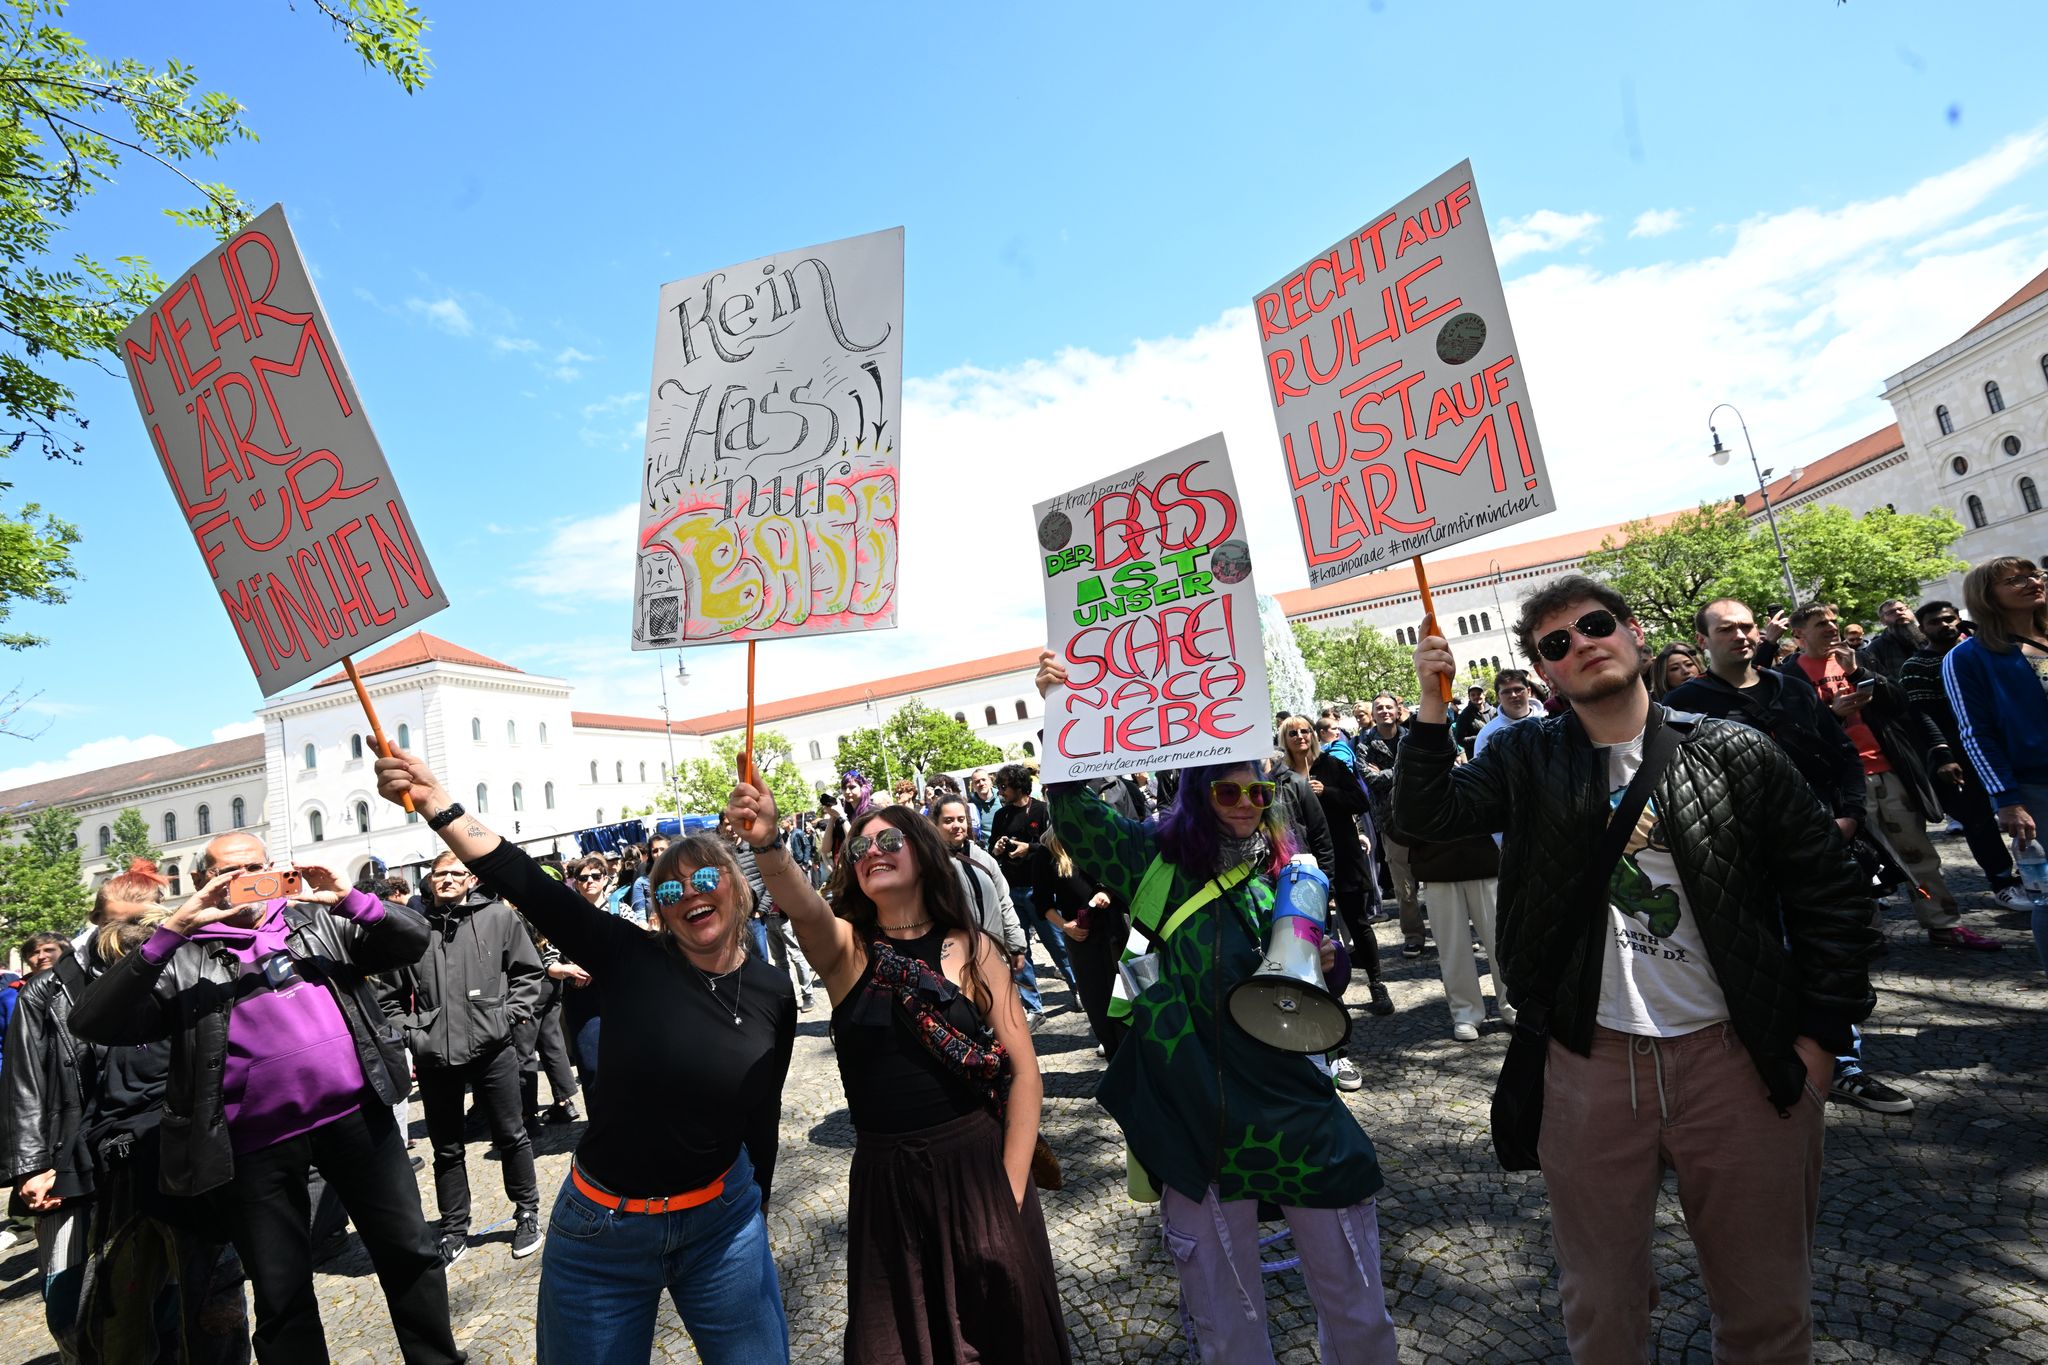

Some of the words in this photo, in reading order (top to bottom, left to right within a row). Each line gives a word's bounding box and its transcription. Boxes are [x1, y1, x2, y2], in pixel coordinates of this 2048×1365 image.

[670, 258, 891, 367] Kein
[1256, 212, 1397, 342] RECHT
[1396, 181, 1471, 259] AUF
[125, 231, 313, 415] MEHR
[1267, 255, 1462, 407] RUHE
[153, 318, 352, 523] LÄRM
[1283, 370, 1425, 491] LUST
[1425, 355, 1514, 440] AUF
[194, 449, 380, 578] FÜR
[705, 461, 851, 526] nur
[1045, 544, 1094, 577] DER
[1084, 460, 1237, 571] BASS
[1295, 401, 1538, 567] LÄRM!
[220, 500, 433, 677] MÜNCHEN
[1073, 571, 1215, 626] UNSER
[1077, 545, 1210, 606] IST
[1310, 547, 1385, 584] #krachparade
[1064, 593, 1237, 690] SCHREI
[1066, 661, 1246, 713] NACH
[1058, 697, 1254, 759] LIEBE
[1068, 746, 1232, 777] @mehrlaermfuermuenchen
